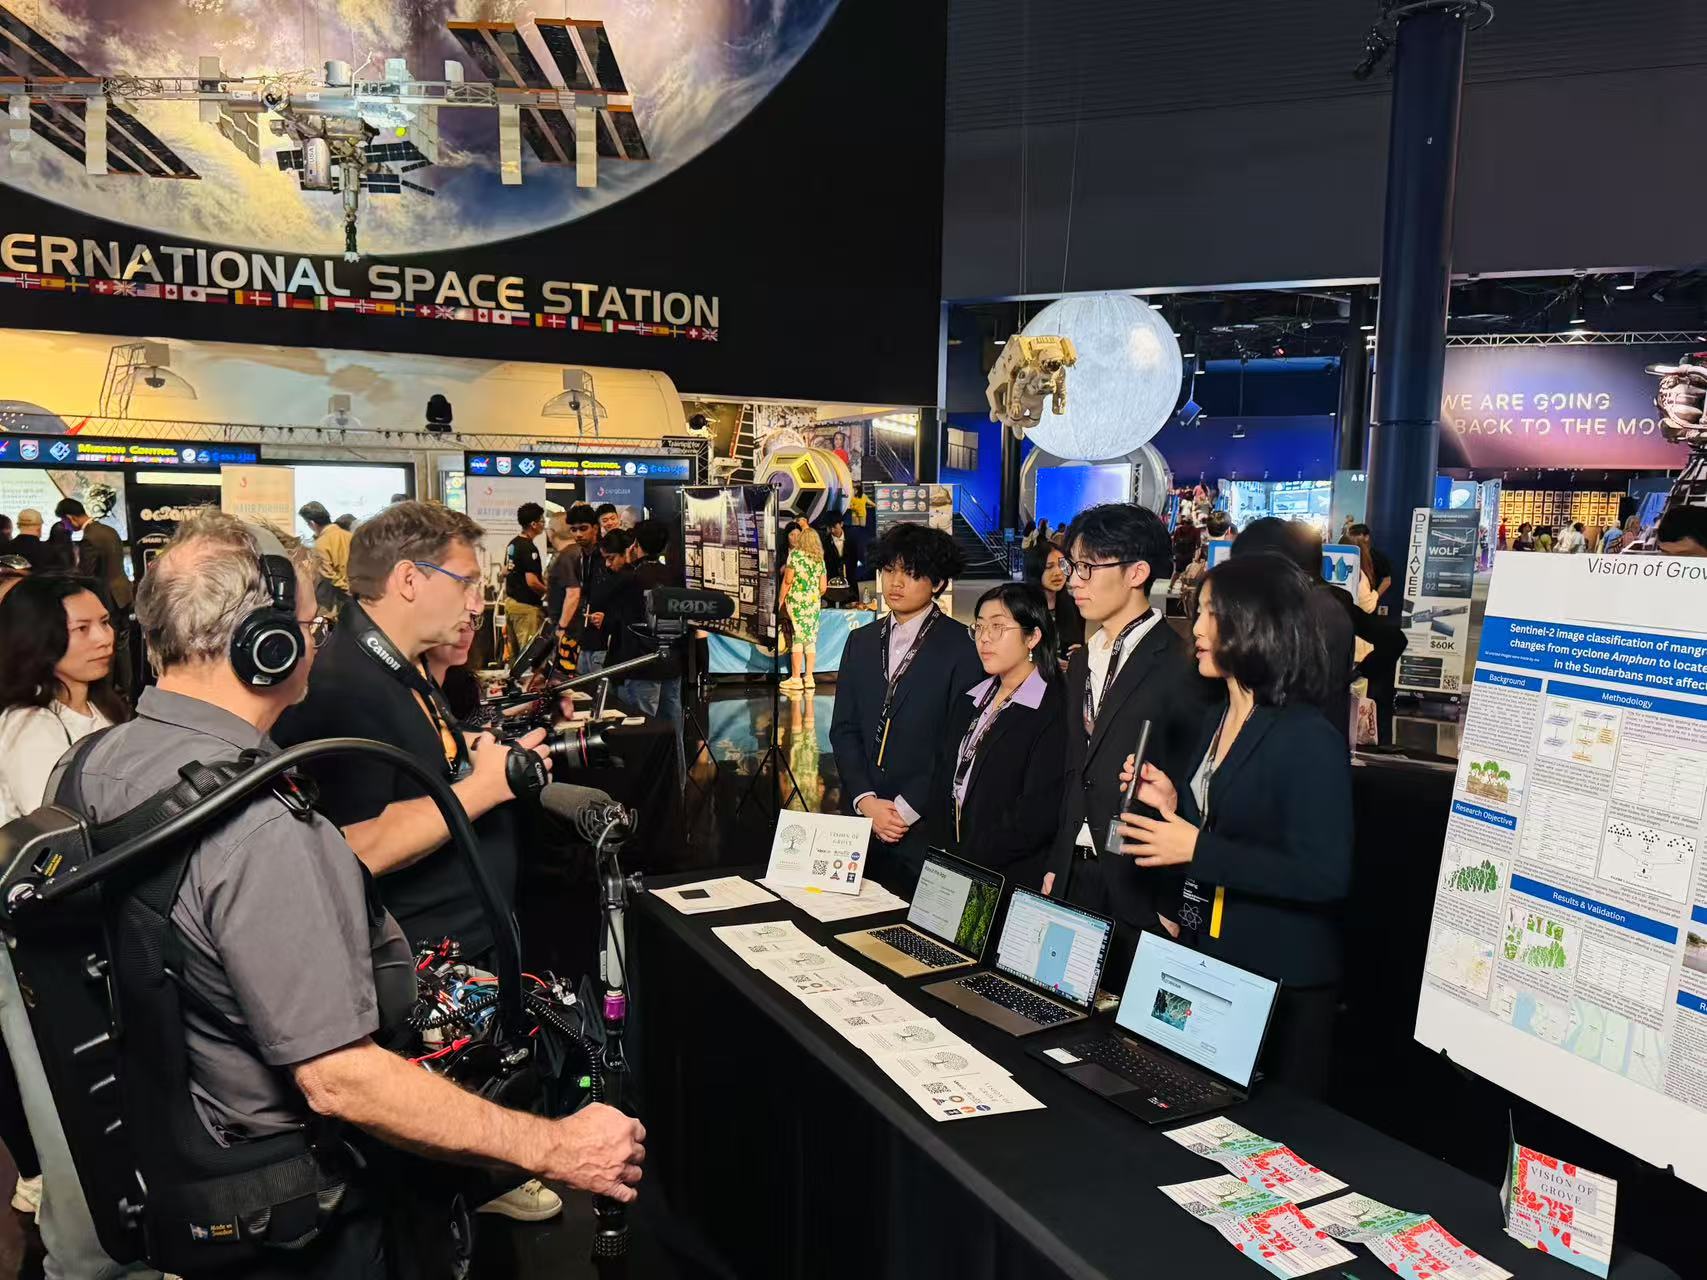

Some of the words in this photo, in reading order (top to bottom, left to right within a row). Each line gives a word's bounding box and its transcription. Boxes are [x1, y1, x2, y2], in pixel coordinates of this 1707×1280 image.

[1, 232, 351, 297] ERNATIONAL
[368, 265, 525, 312] SPACE
[542, 281, 720, 328] STATION
[1441, 394, 1472, 411] WE
[1480, 394, 1524, 411] ARE
[1534, 393, 1611, 410] GOING
[1455, 418, 1513, 435] BACK
[1521, 418, 1551, 435] TO
[1561, 418, 1606, 435] THE
[1617, 418, 1663, 435] MO
[1351, 473, 1368, 481] AR
[1428, 546, 1460, 556] WOLF
[1587, 557, 1638, 576] Vision
[1643, 560, 1662, 577] of
[1430, 640, 1455, 650] $60K
[1510, 623, 1555, 637] Sentinel-2
[1556, 628, 1585, 643] image
[1586, 632, 1654, 650] classification
[1656, 640, 1669, 651] of
[1670, 643, 1707, 659] mangr
[366, 636, 401, 671] Canon
[1510, 638, 1546, 653] changes
[1547, 642, 1570, 655] from
[1571, 646, 1610, 662] cyclone
[1611, 651, 1657, 667] Amphan
[1659, 657, 1671, 668] to
[1488, 673, 1526, 687] Background
[1553, 658, 1564, 669] in
[1565, 660, 1581, 672] the
[1582, 663, 1643, 681] Sundarbans
[1645, 672, 1674, 686] most
[1601, 692, 1653, 709] Methodology
[1455, 803, 1482, 818] Research
[1483, 810, 1513, 826] Objective
[1552, 890, 1580, 907] Results
[1580, 900, 1586, 909] &
[1587, 903, 1626, 924] Validation
[1530, 1165, 1572, 1188] VISION
[1577, 1184, 1594, 1196] OF
[1541, 1183, 1582, 1206] GROVE
[1283, 1214, 1313, 1243] VISION
[1429, 1232, 1463, 1261] VISION
